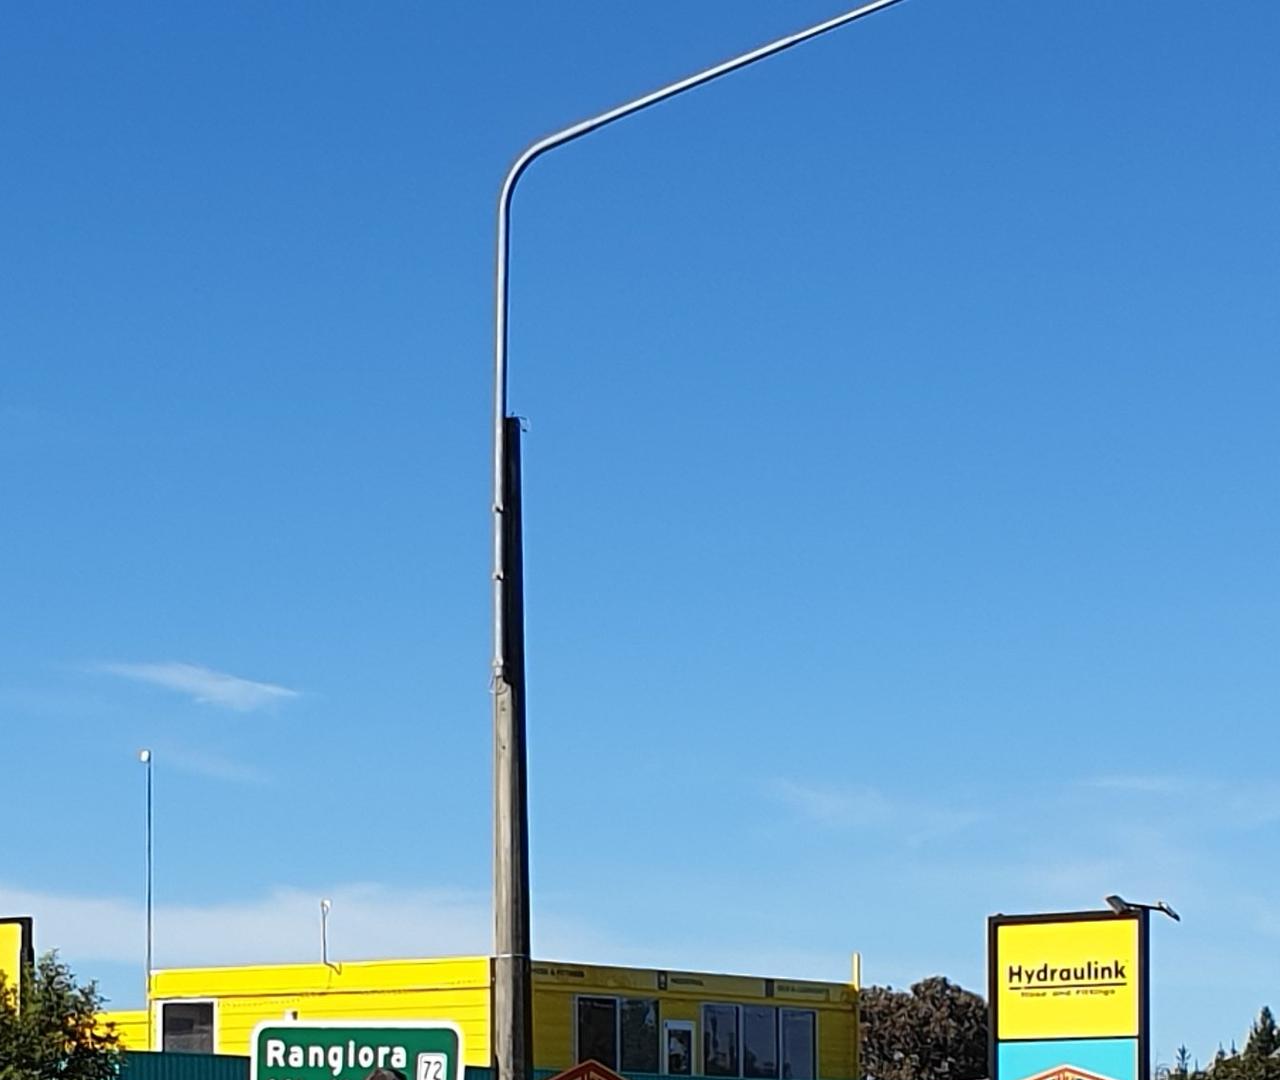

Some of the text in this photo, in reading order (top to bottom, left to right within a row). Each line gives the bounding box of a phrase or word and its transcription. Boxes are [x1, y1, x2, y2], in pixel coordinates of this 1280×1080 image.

[1008, 959, 1126, 984] Hydraulink
[266, 1040, 407, 1076] Rangiora
[423, 1060, 444, 1080] 72
